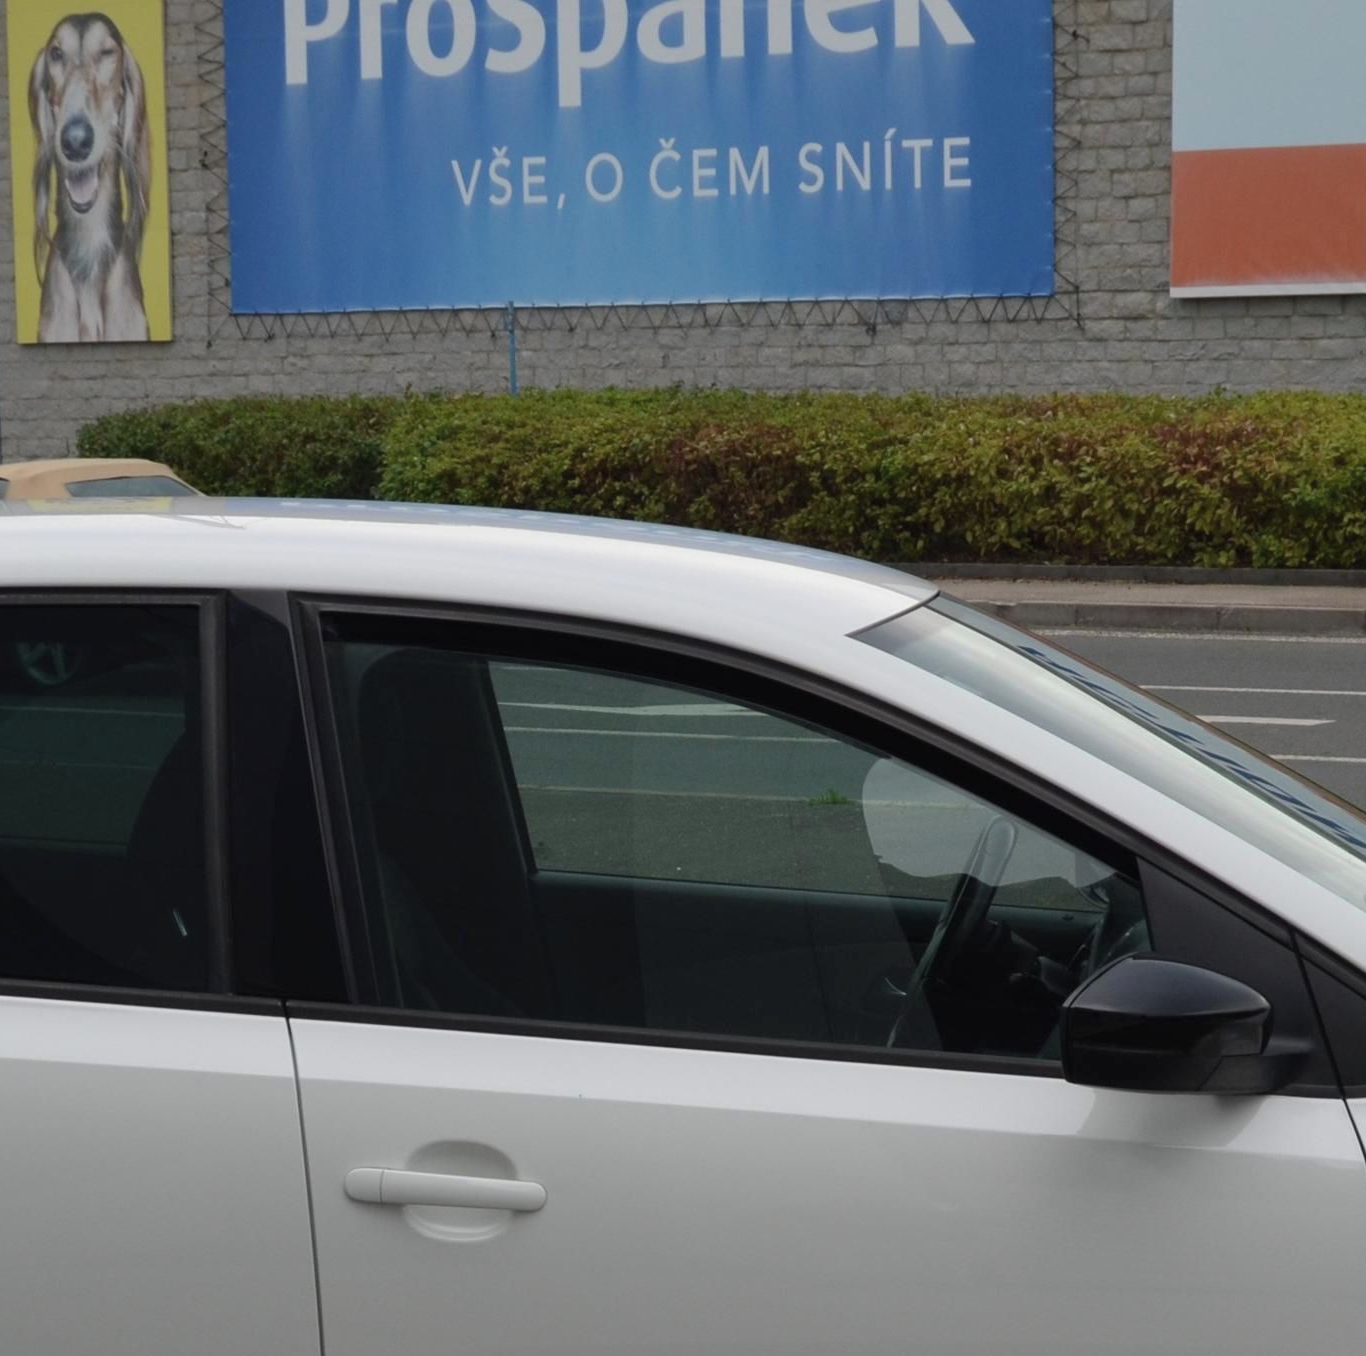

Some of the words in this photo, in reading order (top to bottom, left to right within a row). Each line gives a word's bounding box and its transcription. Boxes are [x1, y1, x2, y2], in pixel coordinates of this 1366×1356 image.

[450, 146, 567, 210] VŠE,
[585, 152, 624, 202] O
[649, 137, 771, 199] ČEM
[797, 128, 972, 194] SNÍTE
